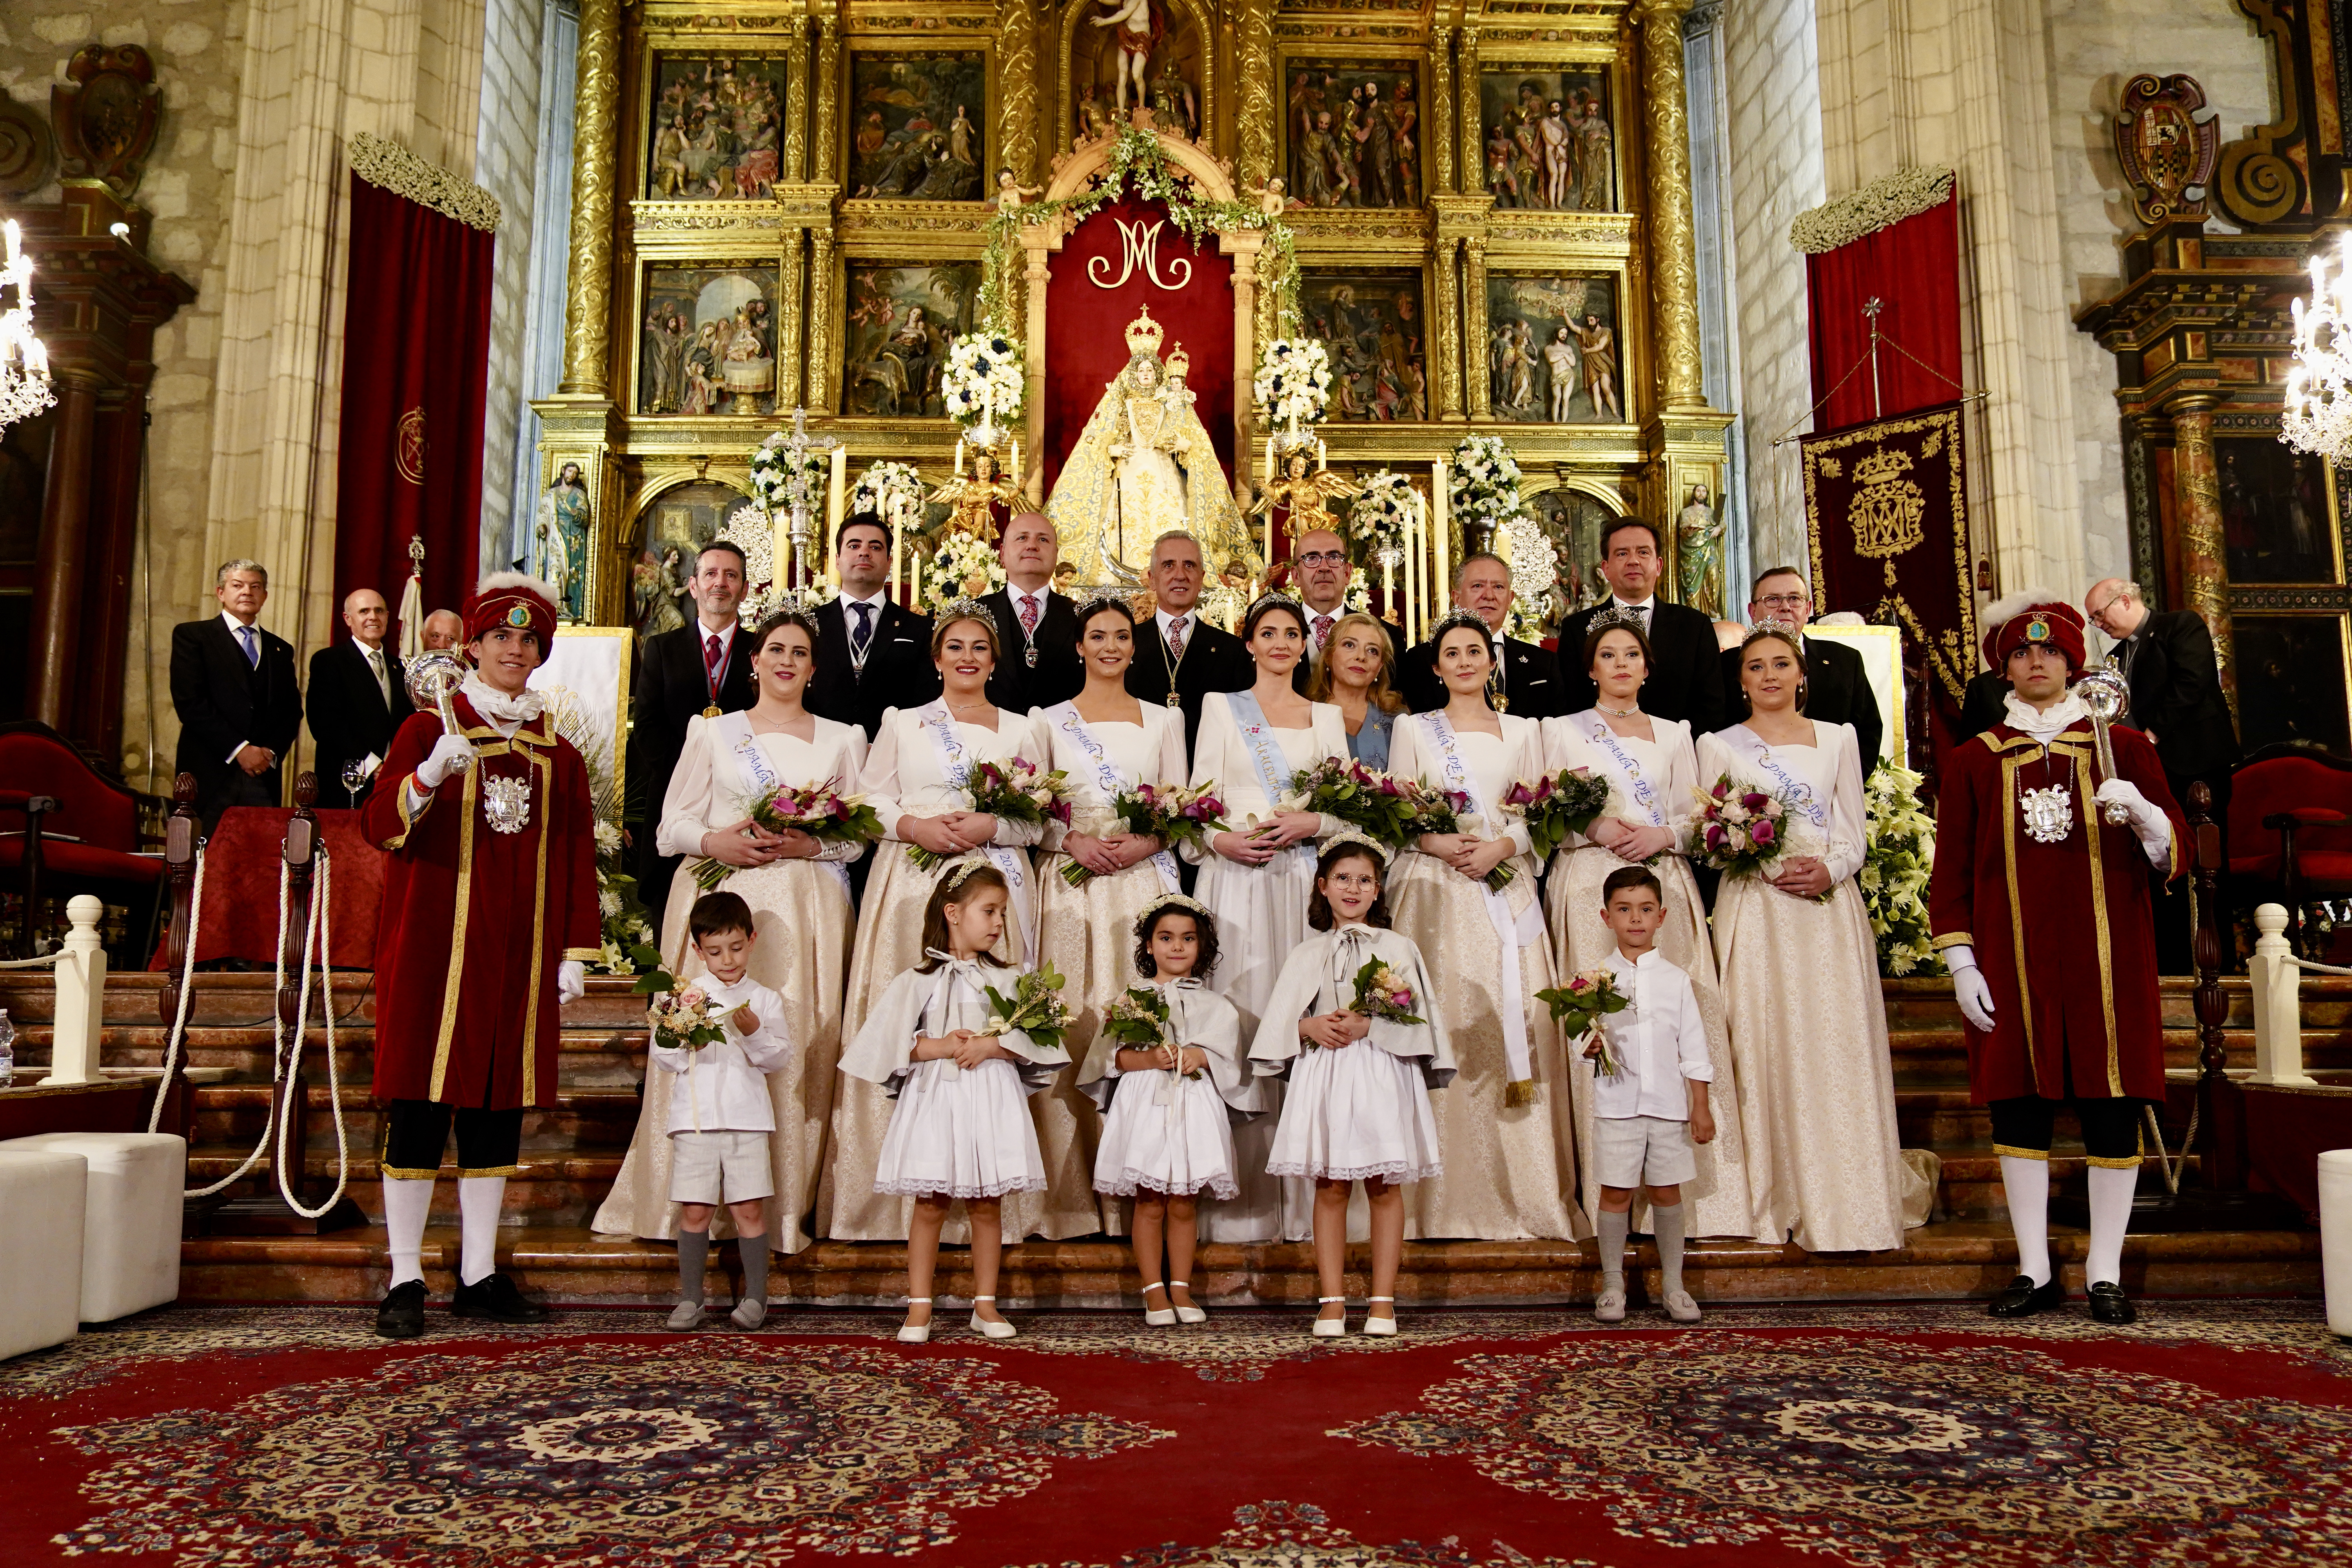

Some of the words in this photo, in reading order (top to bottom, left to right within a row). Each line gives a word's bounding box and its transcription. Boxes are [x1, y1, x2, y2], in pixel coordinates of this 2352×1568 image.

[744, 747, 769, 784] DAMA
[936, 723, 956, 752] DAMA
[953, 764, 969, 785] DE
[1071, 727, 1097, 754] DAMA
[1098, 764, 1117, 784] DE
[1429, 718, 1451, 746] DAMA
[1447, 755, 1463, 773] DE
[1602, 739, 1633, 770] DAMA
[1634, 780, 1652, 799] DE
[1767, 763, 1802, 799] DAMA
[1807, 804, 1824, 822] DE
[999, 854, 1018, 881] 2023
